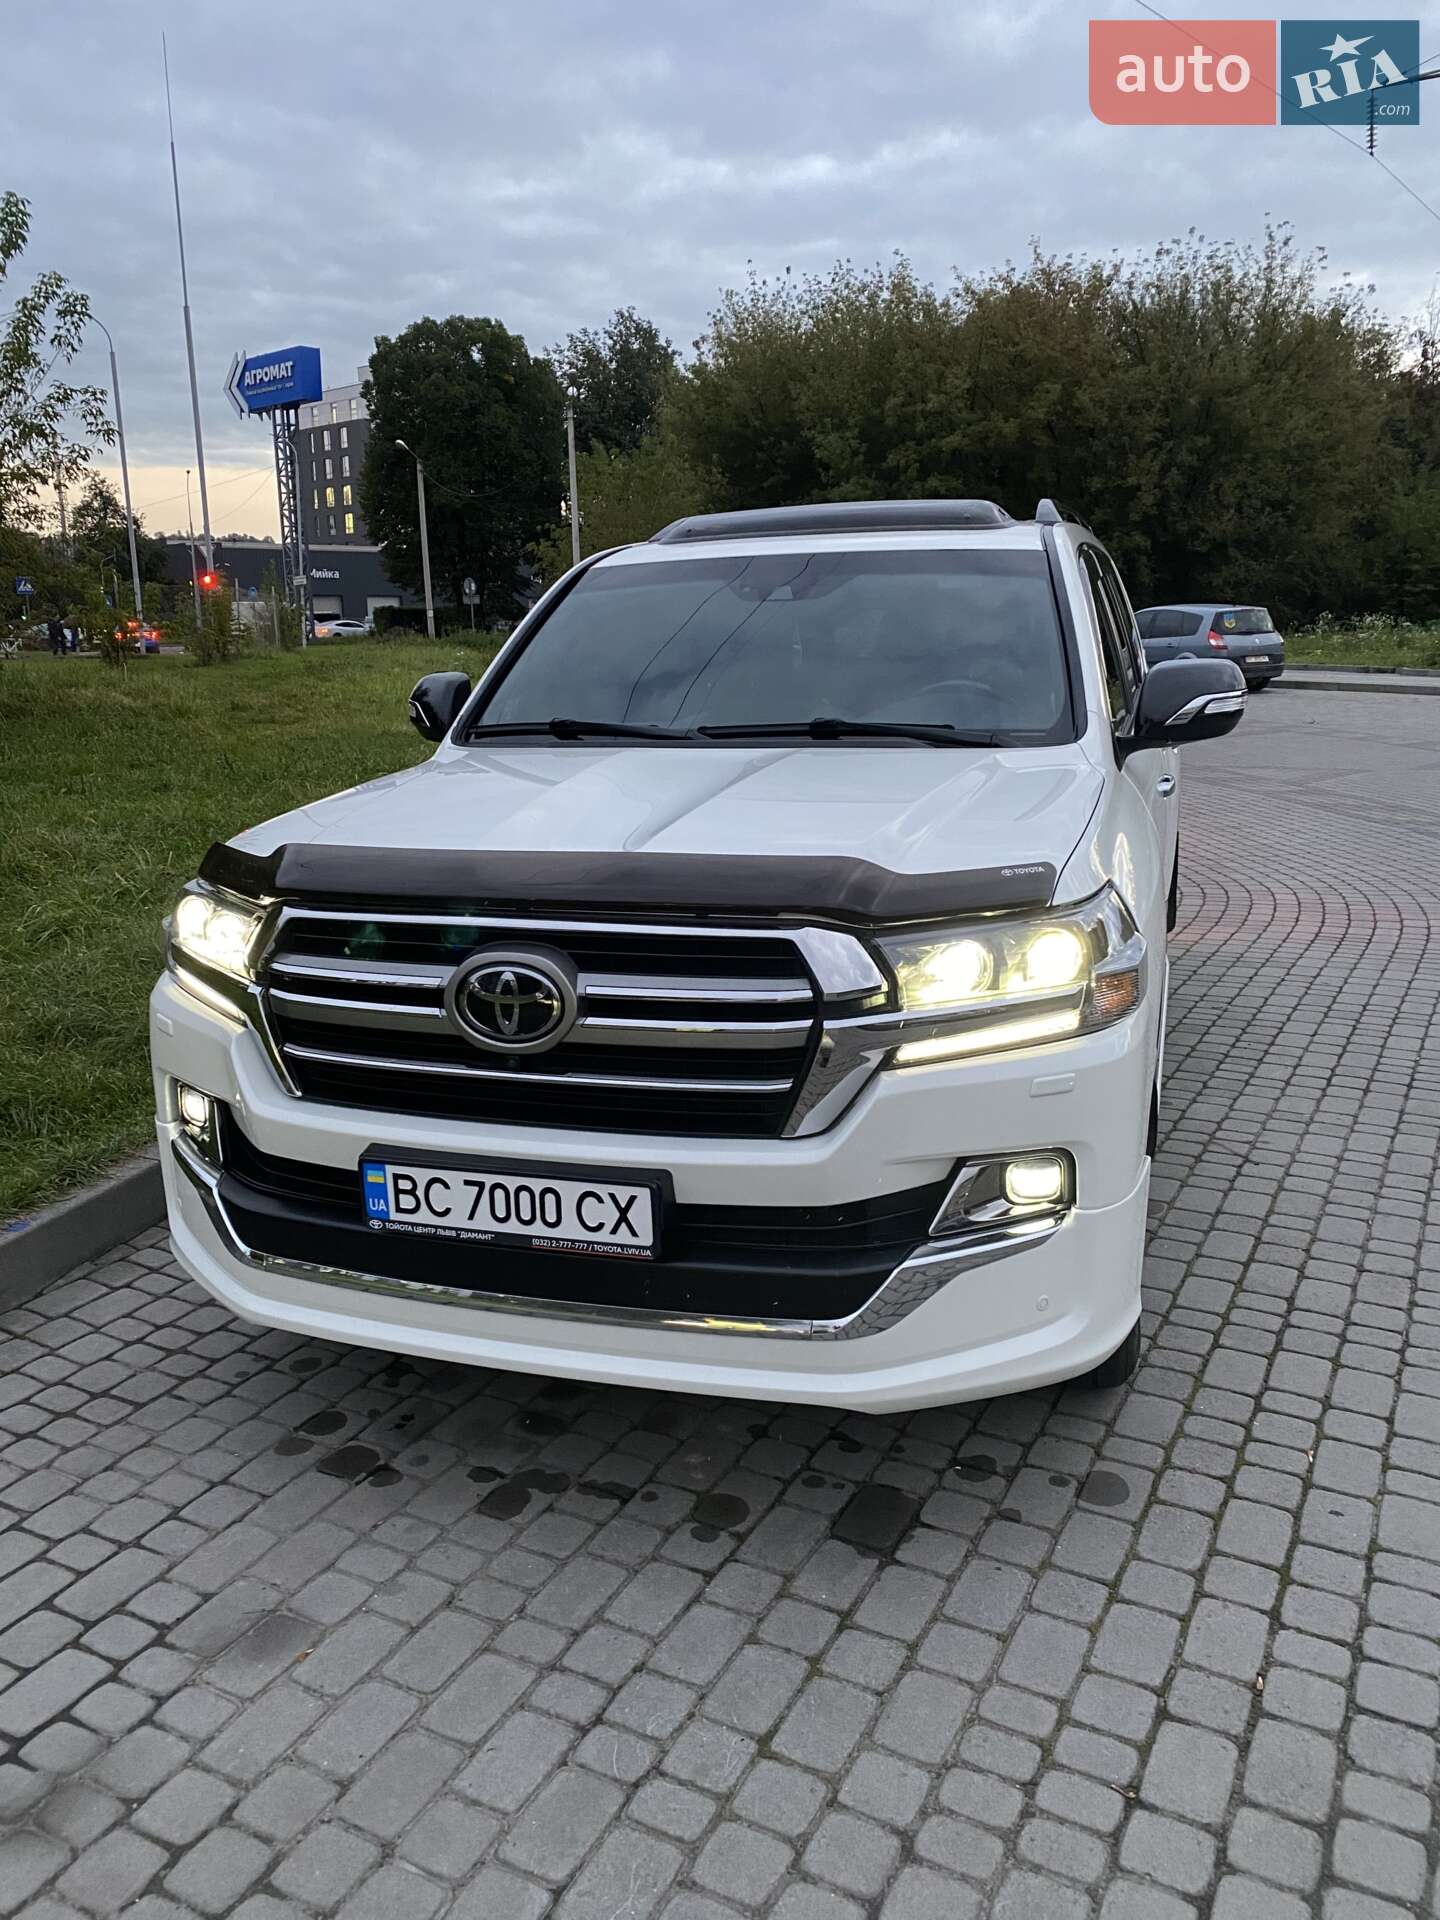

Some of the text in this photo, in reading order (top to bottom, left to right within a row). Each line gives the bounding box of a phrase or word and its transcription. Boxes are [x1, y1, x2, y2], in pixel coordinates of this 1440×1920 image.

[244, 361, 294, 387] АГРОМАТ
[1013, 866, 1045, 874] TOYOTA
[369, 1198, 388, 1212] UA
[392, 1172, 640, 1238] BC 7000 CX
[385, 1222, 413, 1232] ТОЙОТА
[413, 1226, 436, 1235] ЦЕНТР
[532, 1237, 551, 1248] (032)
[551, 1240, 588, 1250] 2-777-777
